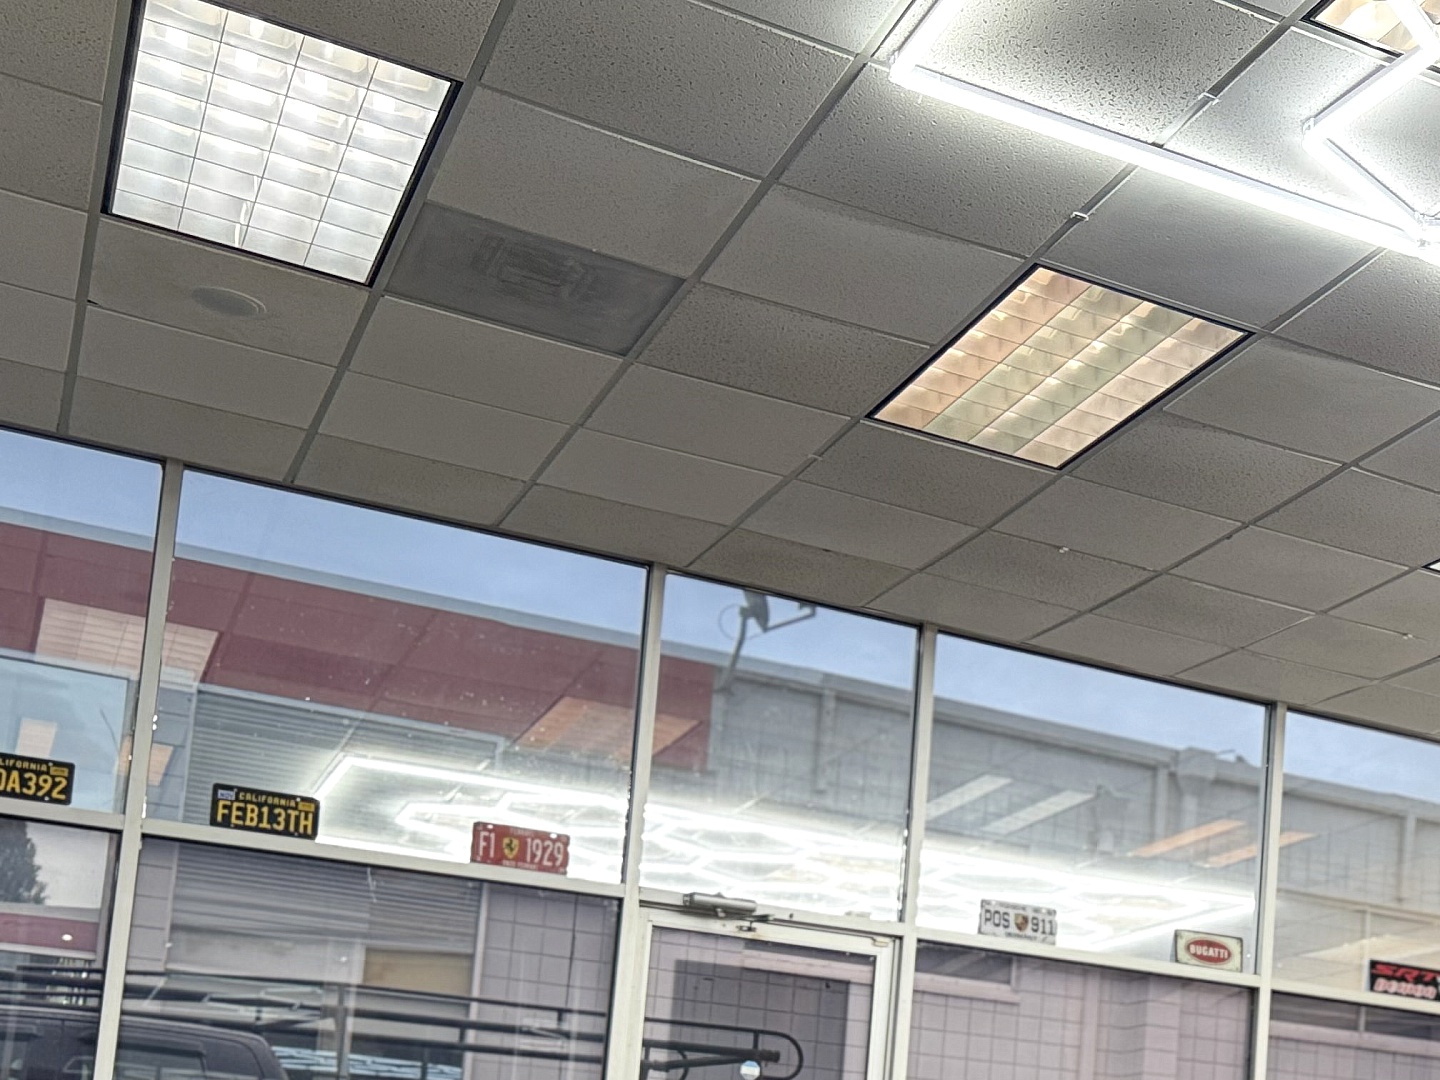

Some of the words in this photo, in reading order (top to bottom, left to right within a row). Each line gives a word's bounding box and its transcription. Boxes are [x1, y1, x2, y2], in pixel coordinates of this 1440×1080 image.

[239, 792, 296, 807] CALIFORNIA
[217, 800, 313, 835] FEB13TH
[479, 831, 496, 858] F1
[527, 838, 564, 866] 1929
[984, 909, 1010, 929] POS
[1031, 916, 1056, 935] 911
[1190, 944, 1228, 959] BUGATTI
[1371, 963, 1440, 982] SRT
